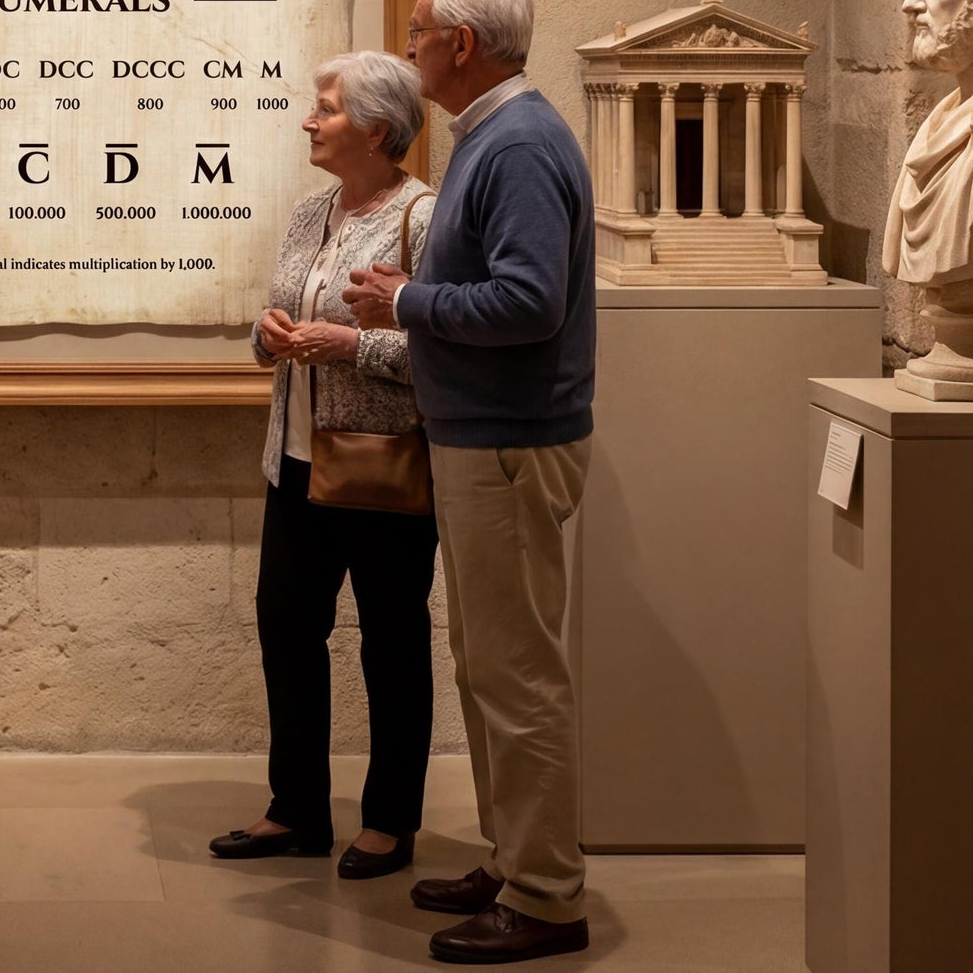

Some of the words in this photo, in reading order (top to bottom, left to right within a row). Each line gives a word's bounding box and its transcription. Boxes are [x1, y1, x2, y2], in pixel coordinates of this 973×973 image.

[39, 59, 94, 79] DCC
[112, 59, 186, 79] DCCC
[203, 59, 243, 79] CM
[260, 60, 282, 79] M
[55, 97, 81, 111] 700
[137, 97, 164, 111] 800
[210, 97, 238, 111] 900
[257, 97, 289, 110] 1000
[9, 206, 66, 220] 100.000
[95, 206, 157, 220] 500.000
[182, 206, 252, 220] 1.000.000
[10, 257, 66, 270] indicates
[68, 257, 157, 273] multiplication
[160, 257, 176, 273] by
